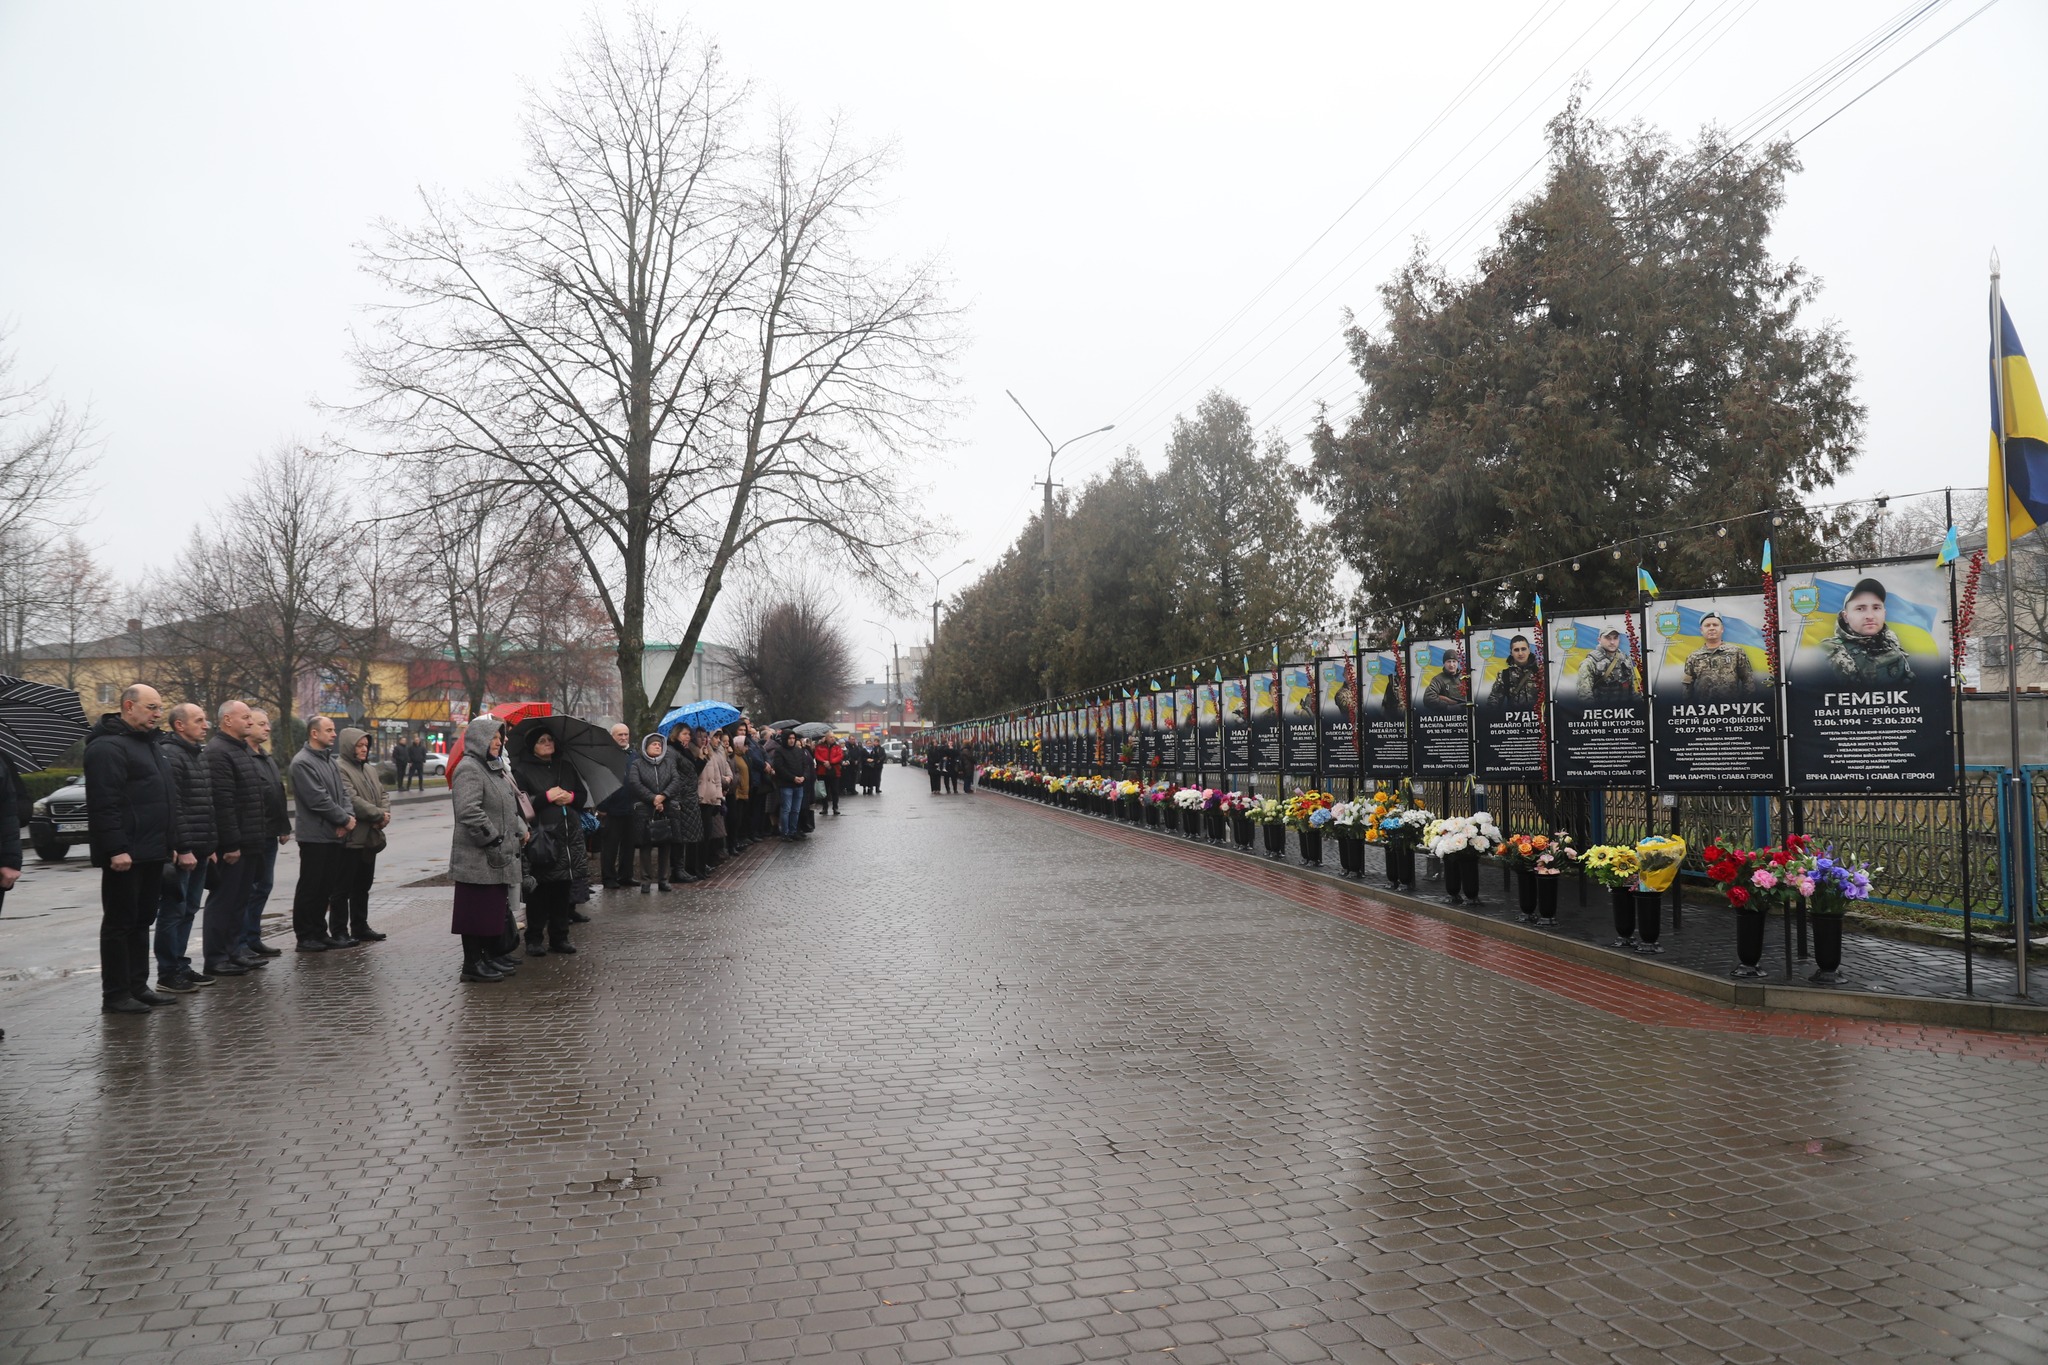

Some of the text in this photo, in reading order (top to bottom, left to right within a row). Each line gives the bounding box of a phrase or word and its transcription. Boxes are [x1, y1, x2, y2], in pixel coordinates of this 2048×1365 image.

[1824, 691, 1908, 706] ГЕМБІК
[1583, 708, 1634, 719] ЛЕСИК
[1673, 703, 1764, 716] НАЗАРЧУК
[1844, 706, 1920, 716] ВАЛЕРІЙОВИЧ
[1506, 712, 1538, 722] РУДЬ
[1703, 716, 1771, 725] ДОРОФІЙОВИЧ
